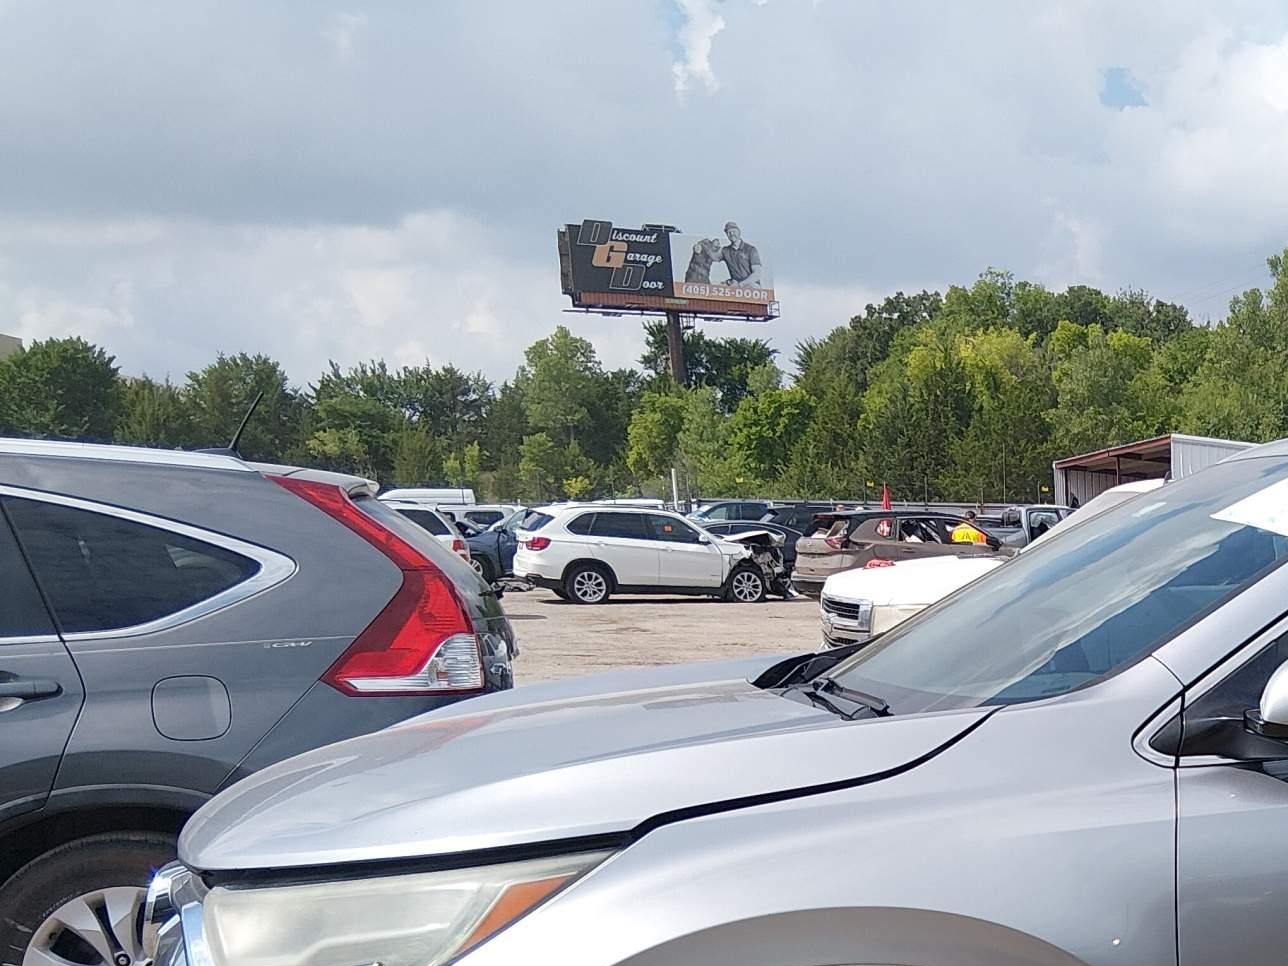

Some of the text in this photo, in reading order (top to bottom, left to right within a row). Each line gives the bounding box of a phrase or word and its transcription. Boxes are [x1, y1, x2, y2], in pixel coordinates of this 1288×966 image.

[577, 219, 658, 246] Discount
[592, 241, 663, 268] Garage
[609, 263, 664, 290] Door
[682, 284, 768, 300] (405) 525-DOOR
